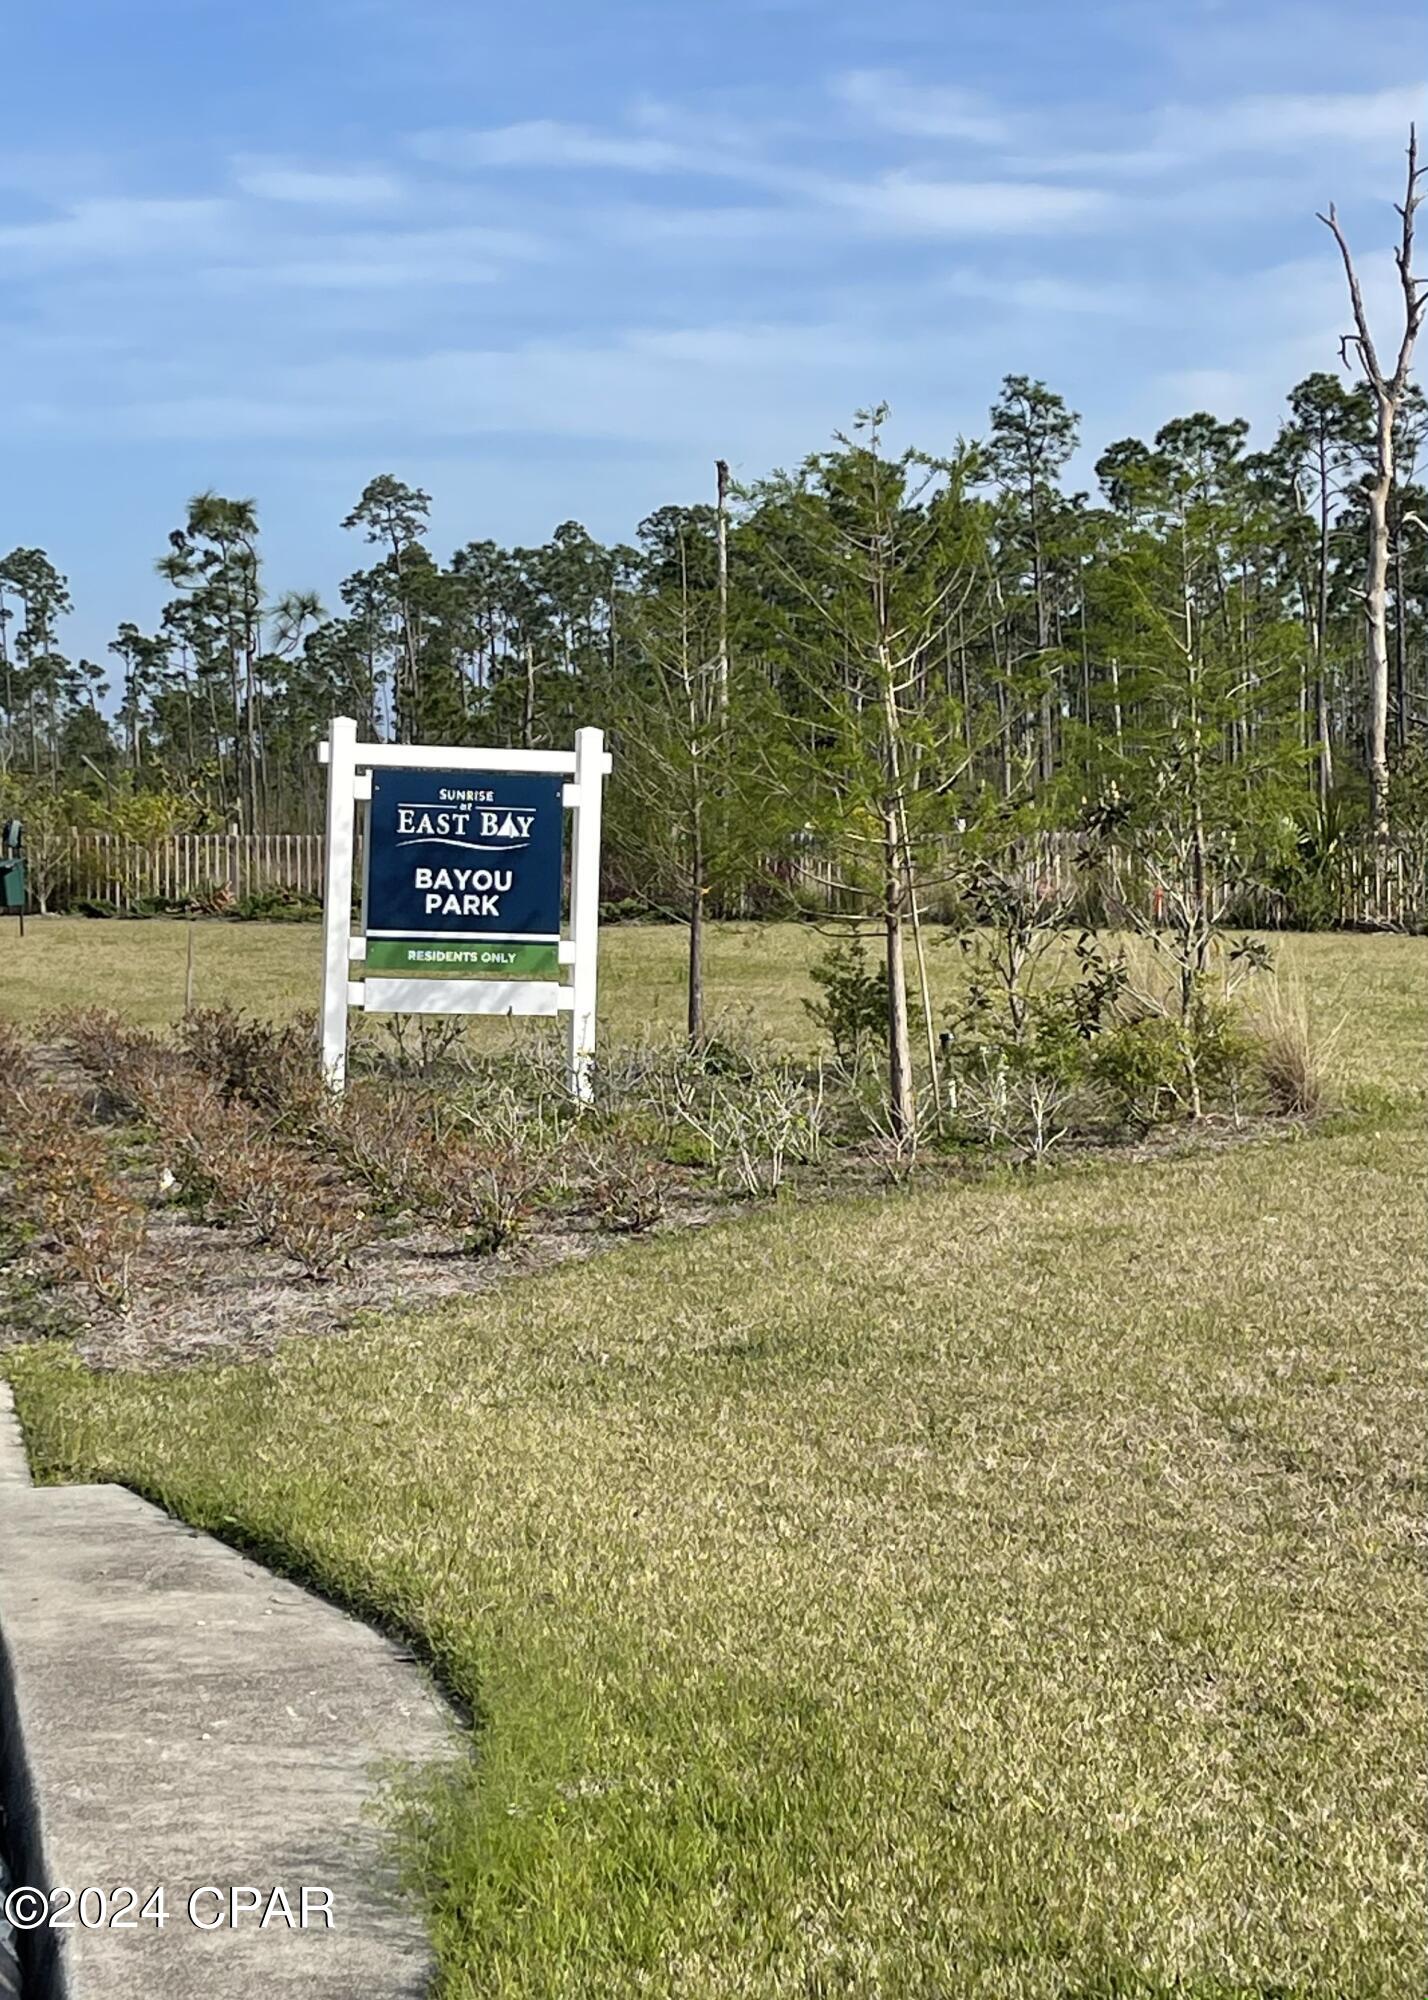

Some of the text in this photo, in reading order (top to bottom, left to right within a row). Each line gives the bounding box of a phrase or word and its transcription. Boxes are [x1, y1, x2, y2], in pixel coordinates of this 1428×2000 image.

[439, 789, 494, 802] SUNRISE
[397, 809, 535, 838] EAST BAY
[415, 868, 513, 891] BAYOU
[425, 894, 500, 916] PARK
[408, 950, 517, 964] RESIDENTS ONLY
